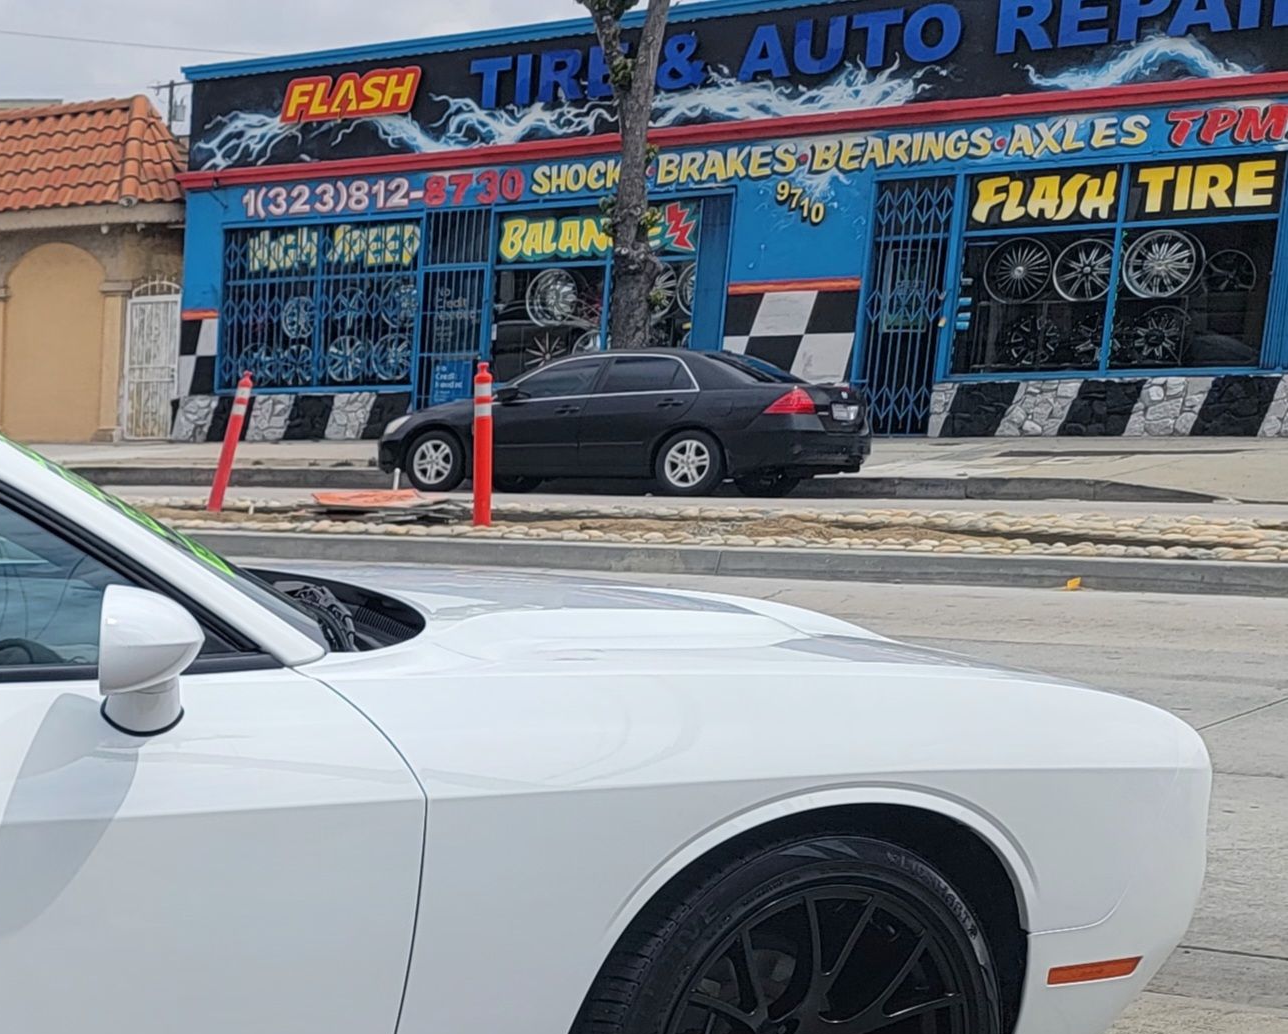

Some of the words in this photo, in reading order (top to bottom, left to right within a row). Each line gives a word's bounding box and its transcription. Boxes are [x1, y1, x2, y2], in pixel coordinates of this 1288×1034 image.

[470, 43, 629, 109] TIRE
[656, 34, 706, 89] &
[737, 3, 962, 81] AUTO
[996, 0, 1288, 54] REPAI
[284, 72, 416, 118] FLASH
[242, 168, 524, 218] 1(323)812-8730
[532, 159, 623, 195] SHOCK
[656, 144, 798, 185] BRAKES
[809, 125, 993, 173] BEARINGS
[1008, 114, 1151, 158] AXLES
[972, 170, 1118, 224] FLASH
[1138, 159, 1277, 213] TIRE
[776, 181, 825, 224] 9710
[500, 213, 667, 260] BALANE
